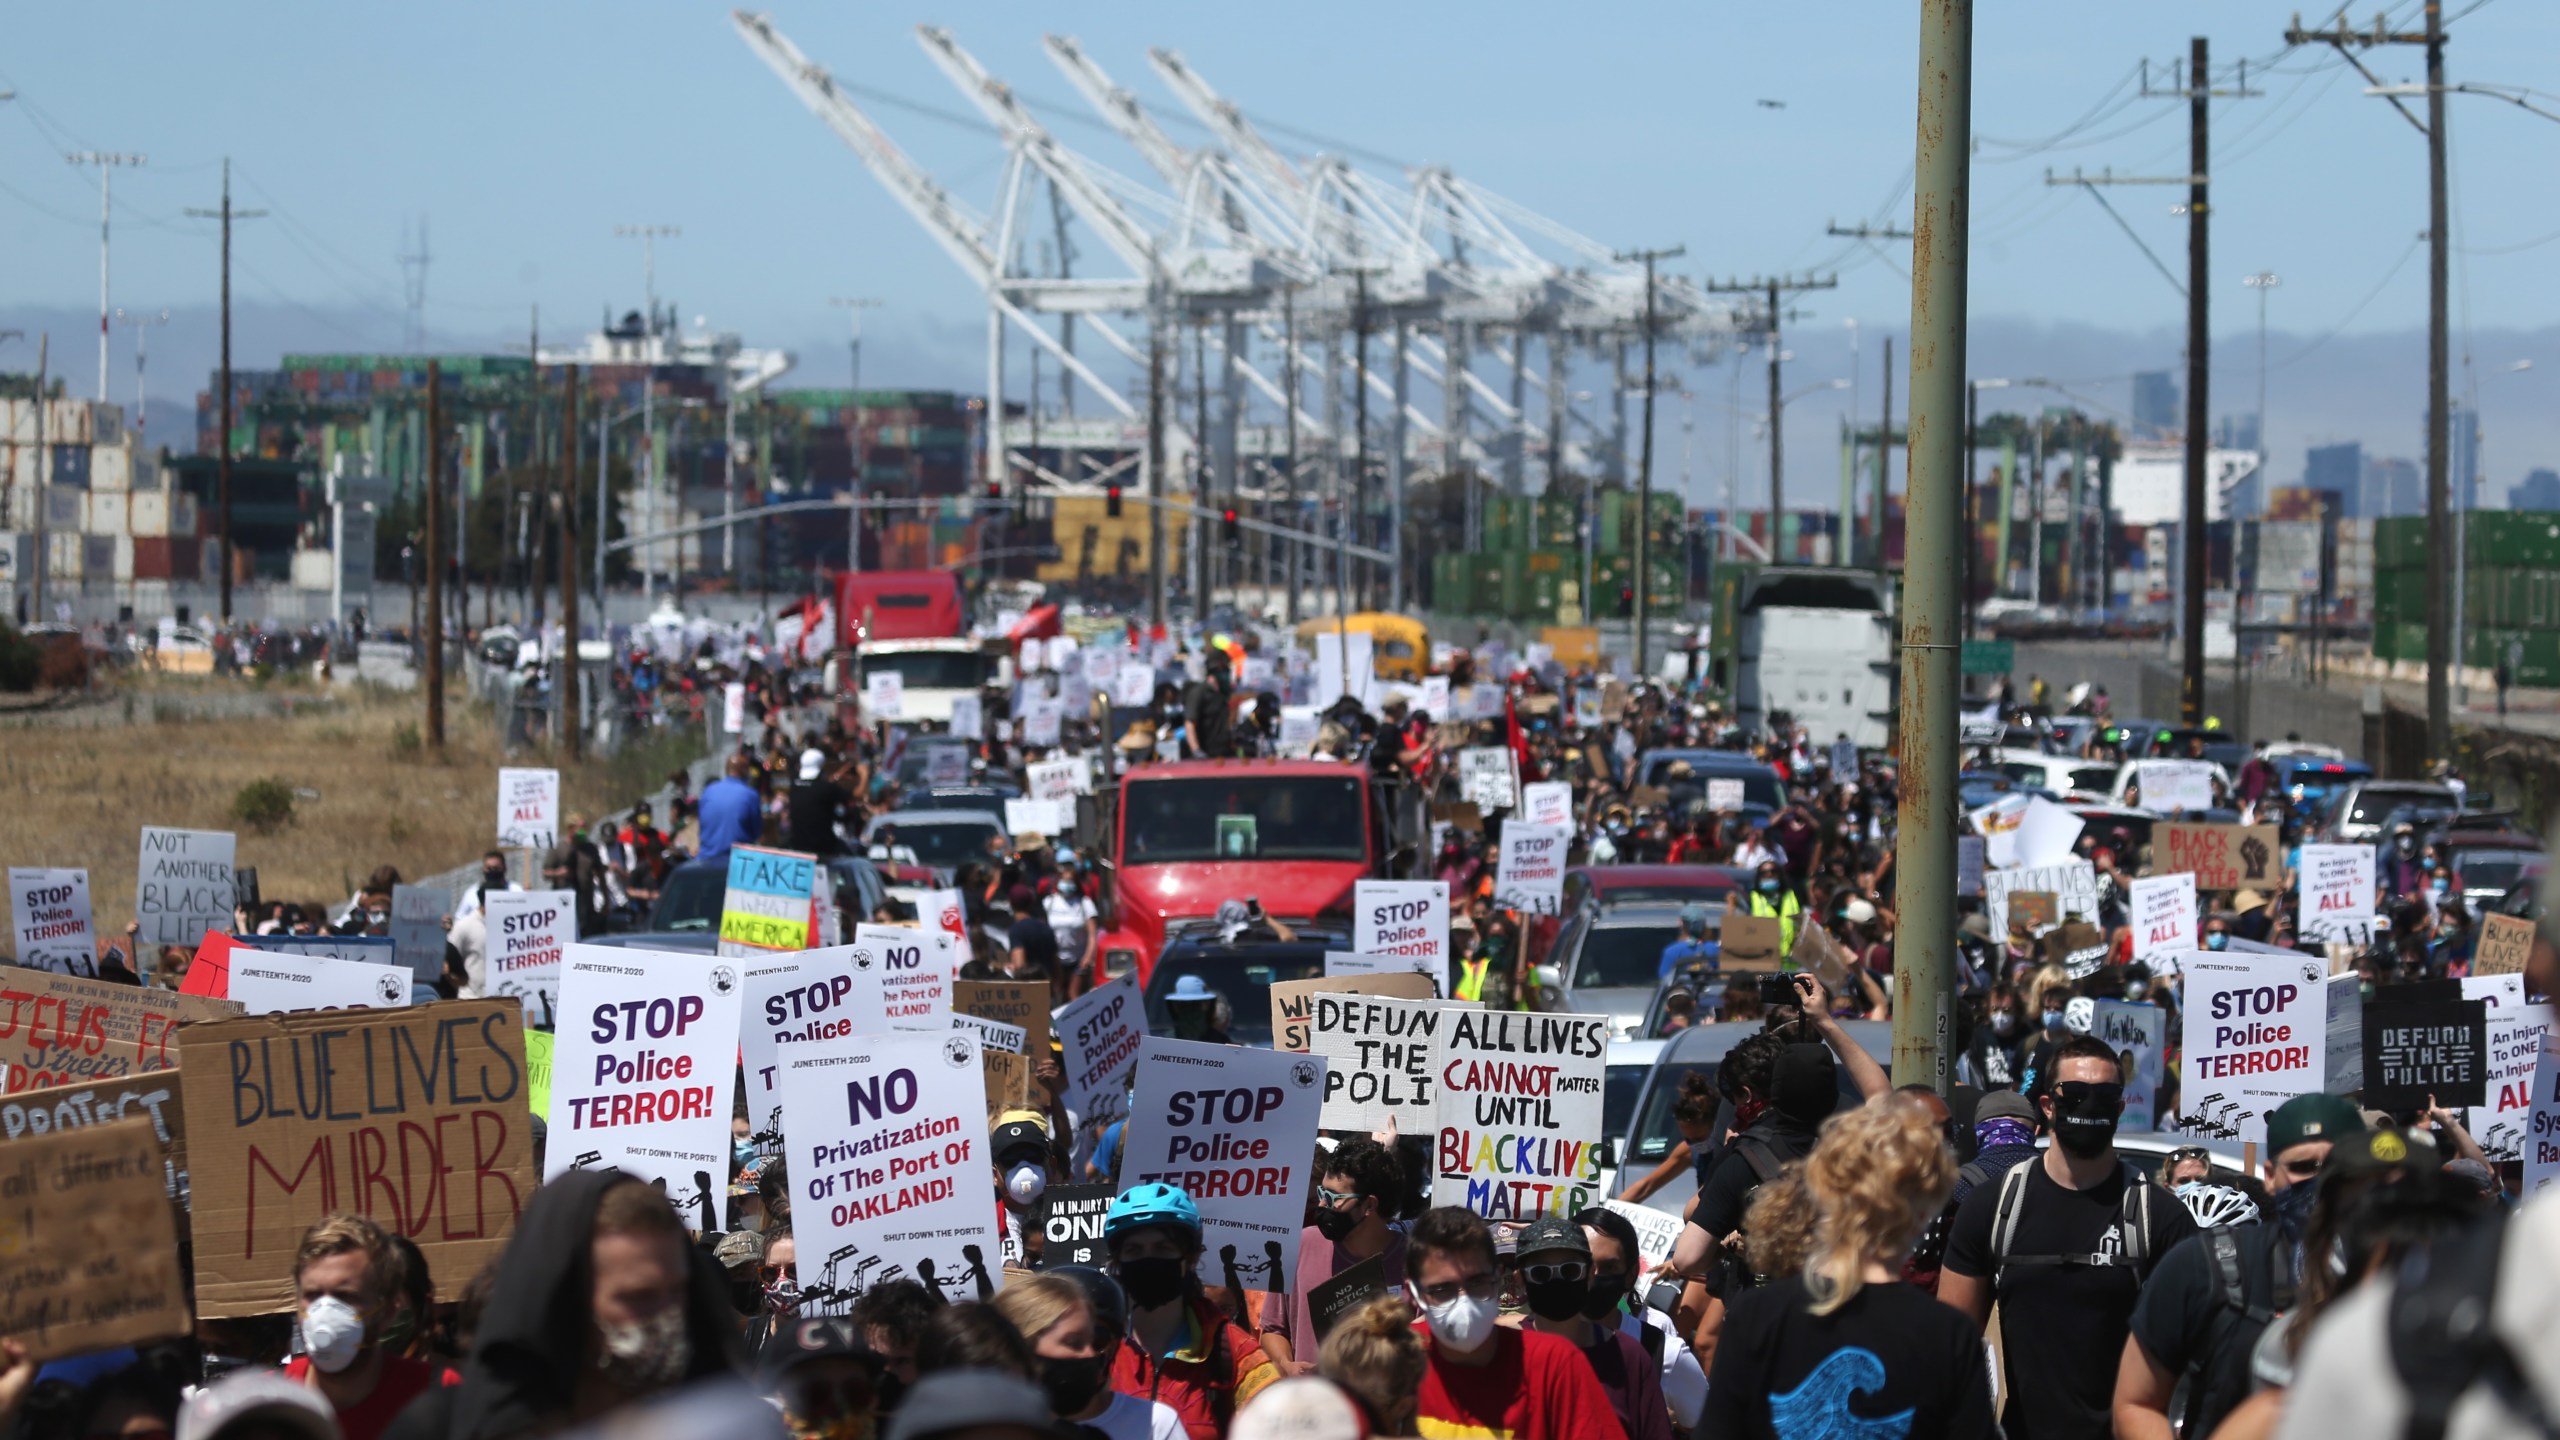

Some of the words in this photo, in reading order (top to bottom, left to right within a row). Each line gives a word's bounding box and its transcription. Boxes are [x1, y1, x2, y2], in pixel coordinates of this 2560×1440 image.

[514, 805, 542, 821] ALL
[145, 832, 191, 854] NOT
[1514, 838, 1555, 853] STOP
[2169, 827, 2229, 850] BLACK
[1515, 855, 1549, 866] Police
[2173, 849, 2226, 870] LIVES
[2333, 858, 2357, 868] Injury
[153, 858, 232, 884] ANOTHER
[737, 856, 811, 892] TAKE
[1505, 867, 1557, 881] TERROR!
[2331, 869, 2347, 877] ONE
[2327, 880, 2350, 890] Injury
[27, 886, 73, 907] STOP
[142, 884, 231, 913] BLACK
[741, 895, 788, 918] WHAT
[2319, 891, 2357, 912] ALL
[32, 908, 73, 923] Police
[503, 909, 557, 935] STOP
[1374, 900, 1430, 926] STOP
[23, 921, 85, 942] TERROR!
[1377, 926, 1426, 944] Police
[2150, 922, 2181, 944] ALL
[2487, 921, 2531, 944] BLACK
[507, 934, 554, 952] Police
[2482, 942, 2523, 964] LIVES
[886, 946, 921, 970] NO
[2194, 963, 2233, 971] JUNETEENTH
[240, 968, 290, 980] JUNETEENTH
[291, 973, 312, 983] 2020
[573, 962, 623, 975] JUNETEENTH
[623, 967, 645, 977] 2020
[745, 967, 782, 978] UNETEENTH
[782, 964, 800, 974] 2020
[48, 980, 73, 992] YORK
[76, 985, 97, 996] NEW
[99, 988, 109, 997] IN
[112, 990, 138, 1002] MADE
[884, 991, 898, 1002] he
[901, 989, 926, 1001] Port
[928, 987, 942, 999] Of
[140, 995, 178, 1010] MATZOS
[765, 974, 852, 1027] STOP
[968, 1003, 1031, 1018] ENRAGED
[2210, 984, 2298, 1020] STOP
[0, 989, 110, 1056] JEWS
[590, 995, 704, 1044] STOP
[1077, 995, 1124, 1047] STOP
[1318, 999, 1440, 1037] DEFUN
[1938, 1015, 1947, 1034] 2
[775, 1017, 852, 1044] Police
[989, 1028, 1021, 1048] LIVES
[1450, 1012, 1516, 1052] ALL
[1524, 1018, 1603, 1058] LIVES
[2119, 1013, 2148, 1047] Wilson
[2216, 1022, 2292, 1048] Police
[2492, 1031, 2509, 1046] An
[2512, 1023, 2549, 1041] Injury
[1083, 1024, 1129, 1065] Police
[2405, 1045, 2448, 1066] THE
[2493, 1049, 2509, 1062] To
[2511, 1040, 2538, 1058] ONE
[595, 1050, 692, 1086] Police
[791, 1056, 847, 1069] JUNETEENTH
[848, 1055, 871, 1065] 2020
[1077, 1034, 1142, 1092] TERROR!
[1151, 1053, 1203, 1066] JUNETEENTH
[1204, 1058, 1224, 1069] 2020
[1355, 1041, 1428, 1075] THE
[1938, 1057, 1945, 1076] 5
[2196, 1046, 2309, 1079] TERROR!
[230, 1030, 362, 1128] BLUE
[363, 1012, 520, 1115] LIVES
[1443, 1058, 1559, 1097] CANNOT
[1557, 1076, 1600, 1094] MATTER
[2384, 1064, 2471, 1086] POLICE
[2486, 1067, 2503, 1081] An
[2506, 1061, 2536, 1076] Injur
[846, 1068, 918, 1126] NO
[2243, 1088, 2259, 1096] SHUT
[2260, 1089, 2278, 1097] DOWN
[568, 1086, 714, 1130] TERROR!
[1167, 1086, 1284, 1127] STOP
[1475, 1094, 1560, 1129] UNTIL
[812, 1116, 960, 1168] Privatization
[1168, 1133, 1269, 1164] Police
[626, 1146, 648, 1157] SHUT
[649, 1148, 671, 1158] DOWN
[673, 1151, 688, 1160] THE
[689, 1152, 718, 1163] PORTS!
[1440, 1127, 1535, 1175] BLACK
[1537, 1138, 1602, 1182] LIVES
[808, 1174, 834, 1201] Of
[841, 1165, 884, 1193] The
[889, 1149, 939, 1183] Port
[944, 1139, 971, 1165] Of
[244, 1110, 521, 1261] MURDER
[831, 1176, 954, 1228] OAKLAND!
[1052, 1201, 1065, 1216] AN
[1067, 1198, 1102, 1215] INJURY
[1466, 1178, 1589, 1221] MATTER
[883, 1233, 905, 1243] SHUT
[907, 1231, 934, 1241] DOWN
[936, 1229, 953, 1239] THE
[955, 1227, 985, 1238] PORTS!
[1219, 1218, 1244, 1229] DOWN
[1244, 1222, 1261, 1231] THE
[1261, 1224, 1290, 1235] PORTS!
[1643, 1215, 1677, 1235] LIVES
[1073, 1248, 1092, 1263] IS
[1323, 1284, 1370, 1316] JUSTICE
[1335, 1284, 1353, 1298] NO
